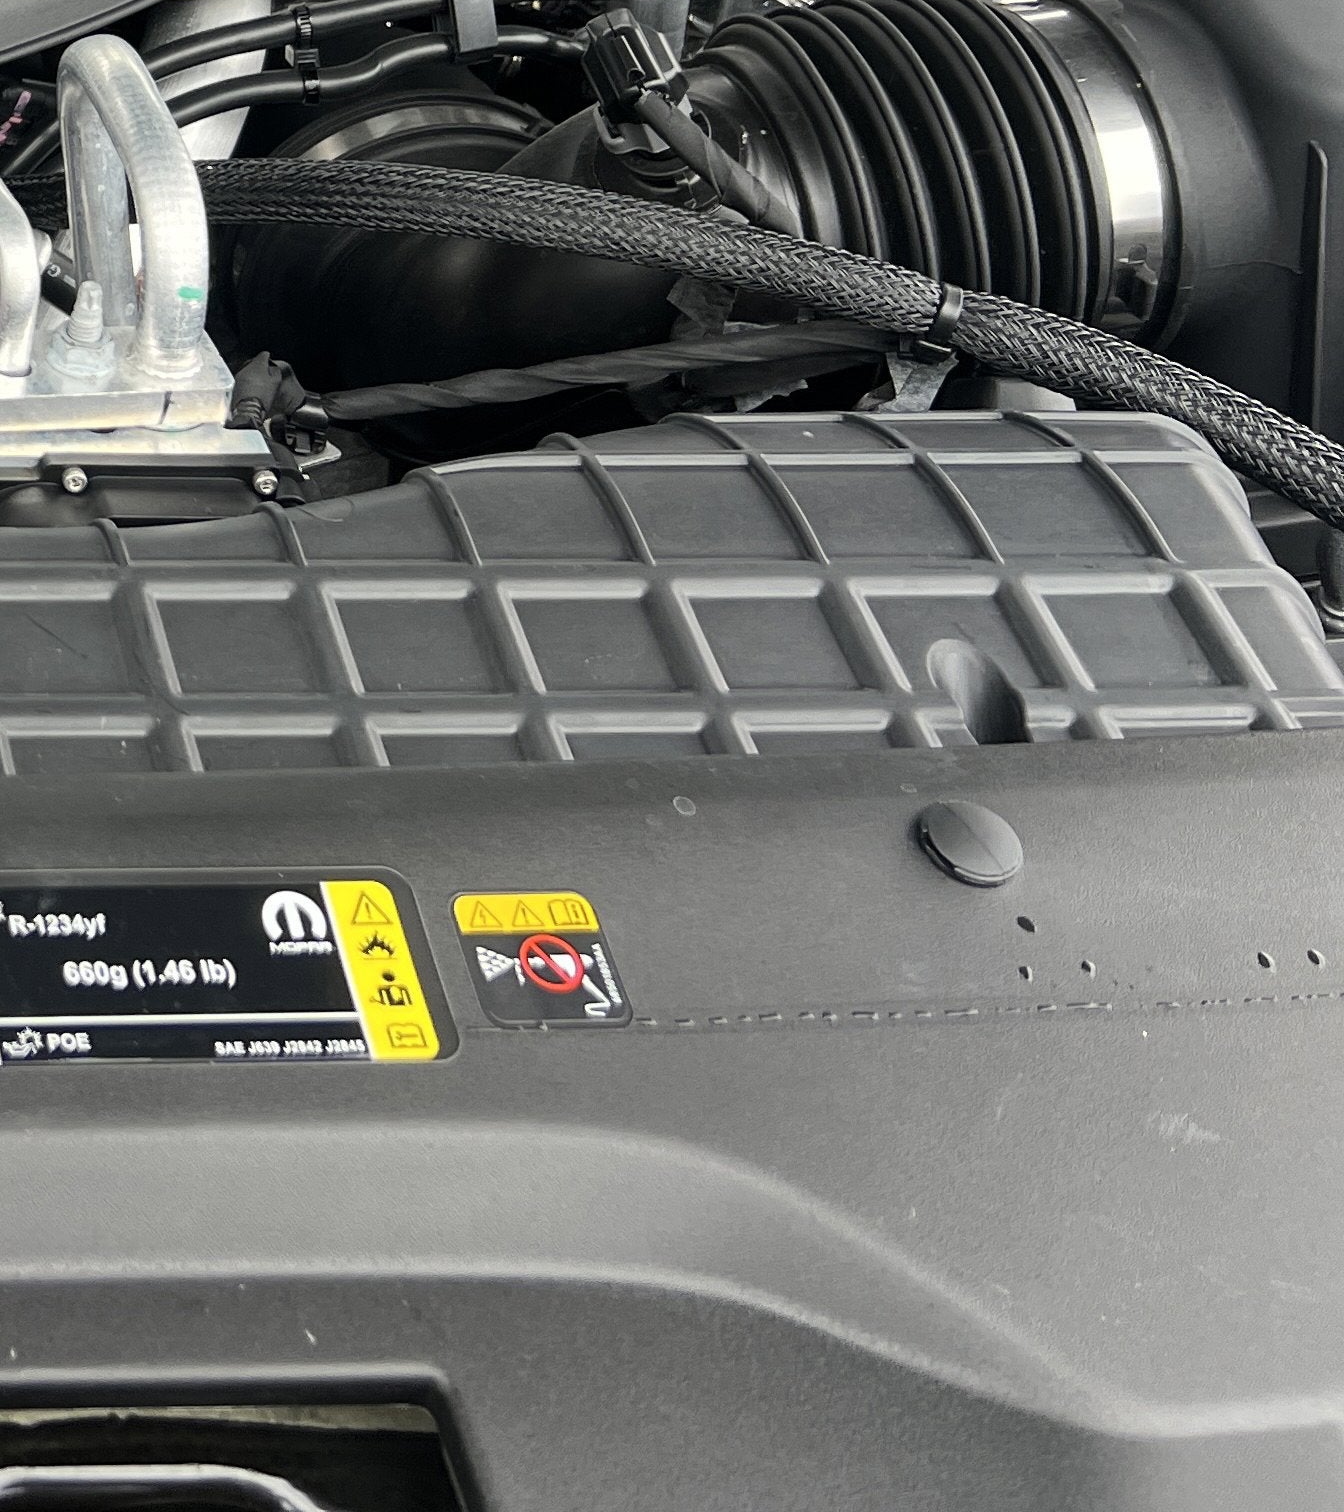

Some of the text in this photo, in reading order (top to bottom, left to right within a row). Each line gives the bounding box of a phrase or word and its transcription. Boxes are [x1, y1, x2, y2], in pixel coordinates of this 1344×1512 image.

[8, 912, 106, 941] R-1234yf
[269, 941, 333, 956] MOPAR
[63, 958, 237, 991] 660g (1.46 lb)
[45, 1032, 92, 1054] POE
[214, 1041, 246, 1058] SAE
